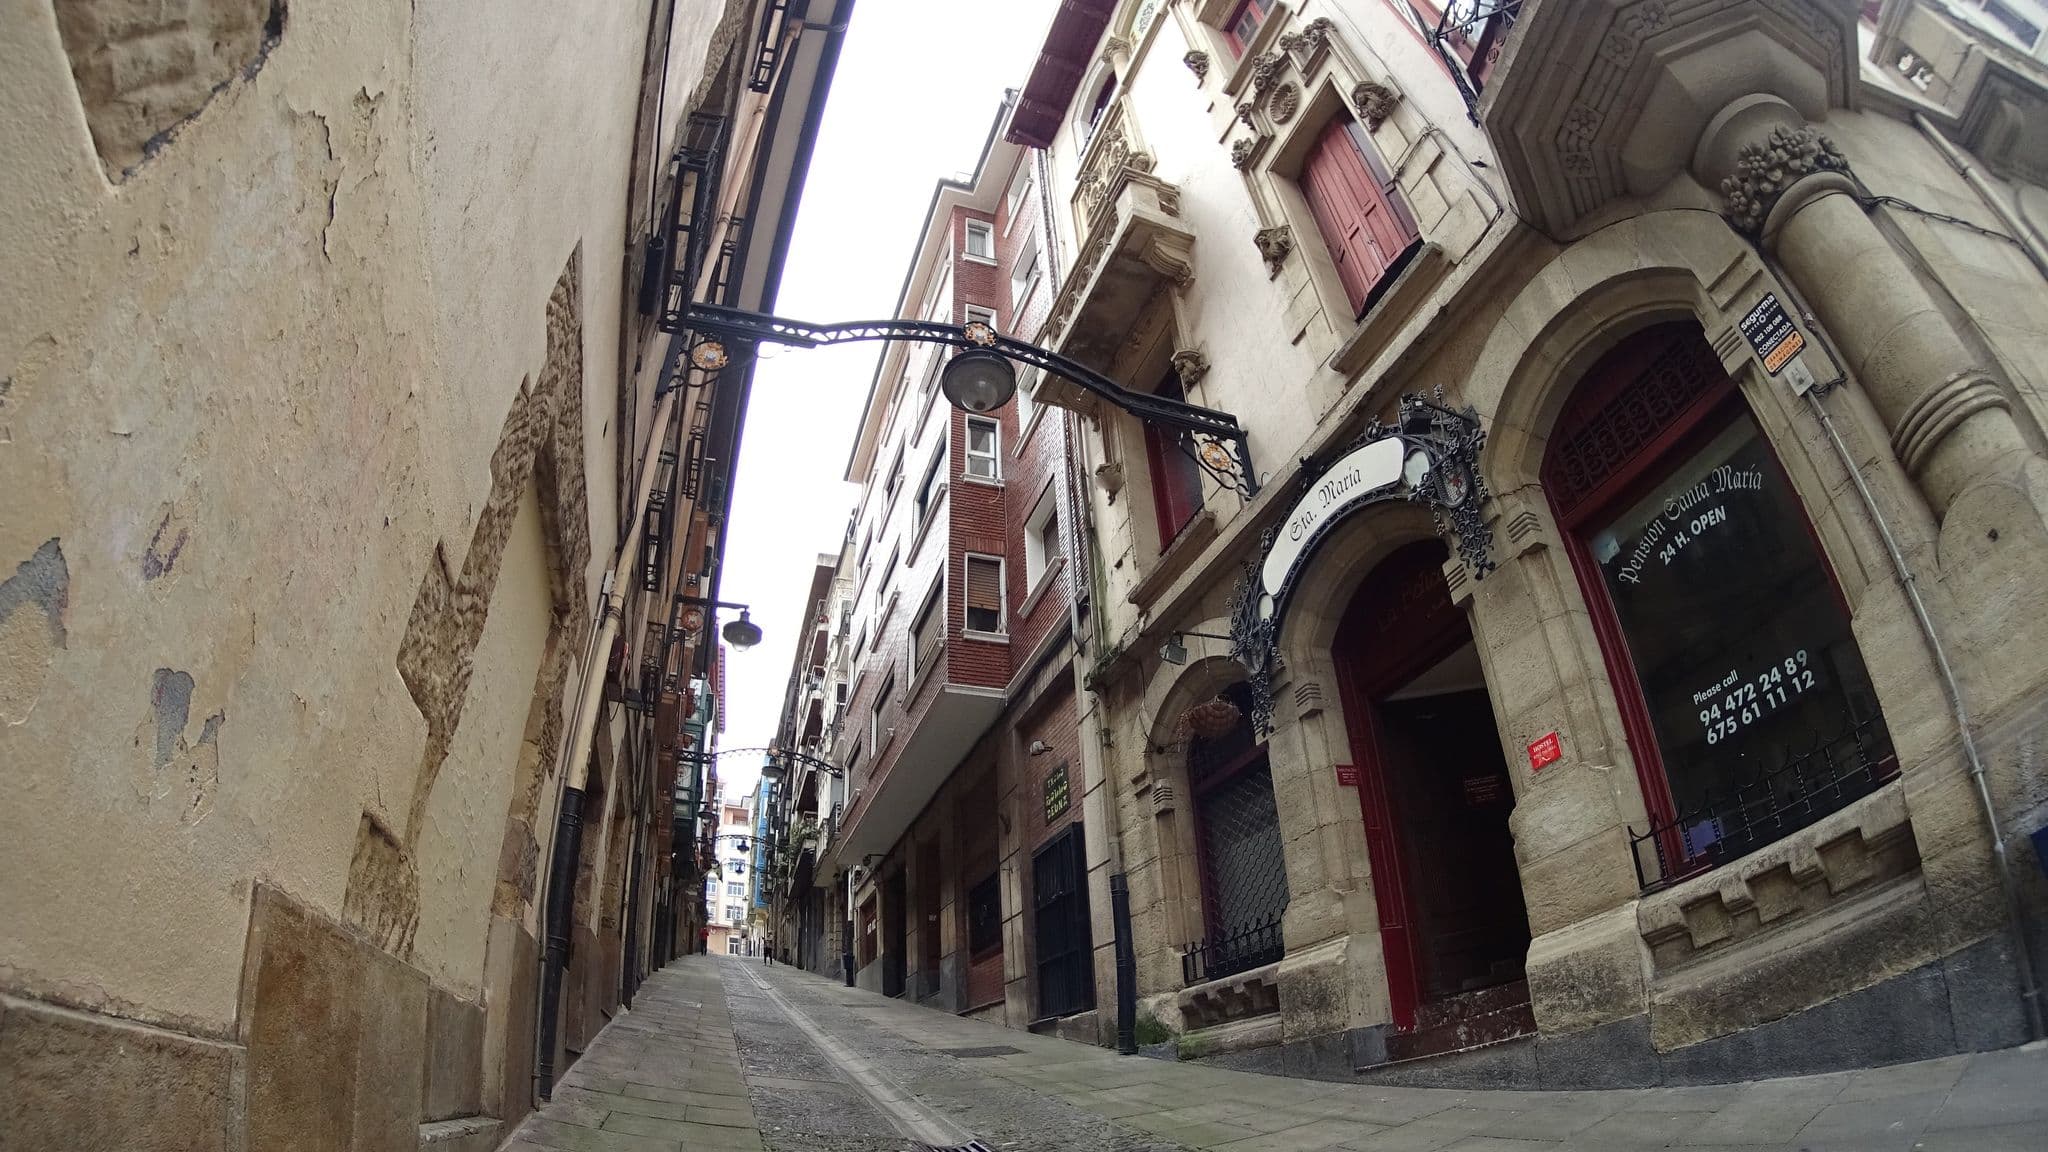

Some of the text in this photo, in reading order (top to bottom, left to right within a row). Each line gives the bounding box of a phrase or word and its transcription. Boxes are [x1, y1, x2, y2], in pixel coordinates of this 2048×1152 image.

[1741, 294, 1775, 330] segurma
[1758, 321, 1792, 354] CONECTADA
[1290, 512, 1317, 541] Sta.
[1618, 464, 1763, 584] Pensión Santa María
[1659, 505, 1726, 566] 24 H. OPEN
[1693, 669, 1739, 705] Please call
[1700, 649, 1808, 727] 94 472 24 89
[1707, 670, 1815, 744] 675 61 11 12
